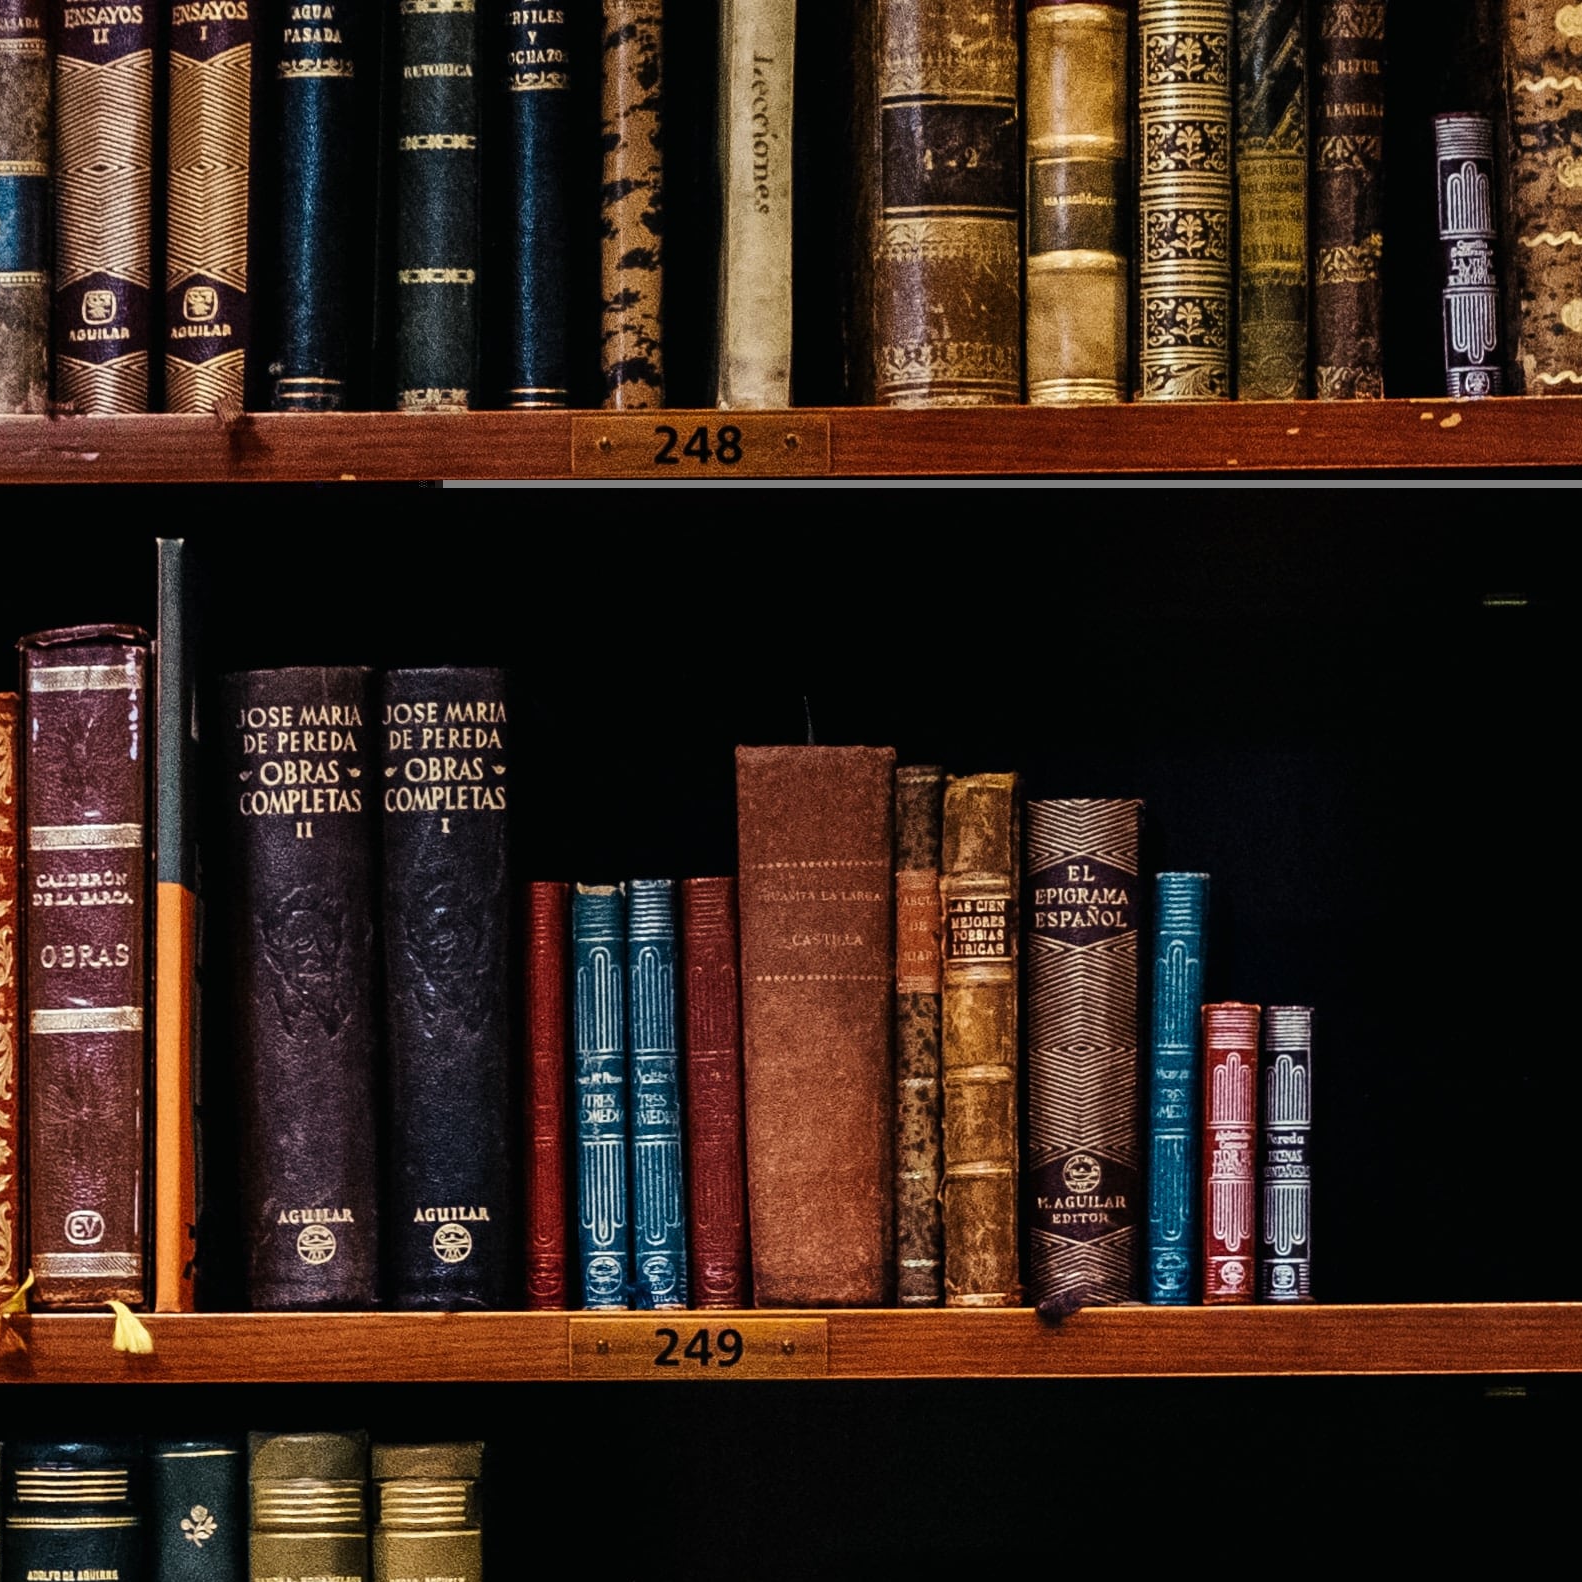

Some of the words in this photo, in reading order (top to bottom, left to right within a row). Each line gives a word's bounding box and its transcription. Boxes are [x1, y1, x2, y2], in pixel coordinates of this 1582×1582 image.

[64, 5, 144, 27] ENSAYOS
[751, 51, 776, 216] Lecciones
[654, 425, 742, 465] 248
[236, 706, 293, 729] JOSE
[299, 704, 362, 727] MARIA
[382, 702, 438, 725] JOSE
[444, 701, 507, 724] MARIA
[244, 733, 268, 754] DE
[277, 731, 357, 753] PEREDA
[389, 729, 413, 751] DE
[421, 727, 502, 749] PEREDA
[260, 760, 339, 786] OBRAS
[404, 756, 484, 782] OBRAS
[240, 789, 362, 815] COMPLETAS
[385, 786, 506, 812] COMPLETAS
[1068, 866, 1095, 883] EL
[1035, 888, 1128, 906] EPIGRAMA
[1035, 905, 1127, 928] ESPAÑOL
[41, 943, 130, 969] OBRAS
[277, 1208, 354, 1225] AGUILAR
[654, 1328, 744, 1367] 249
